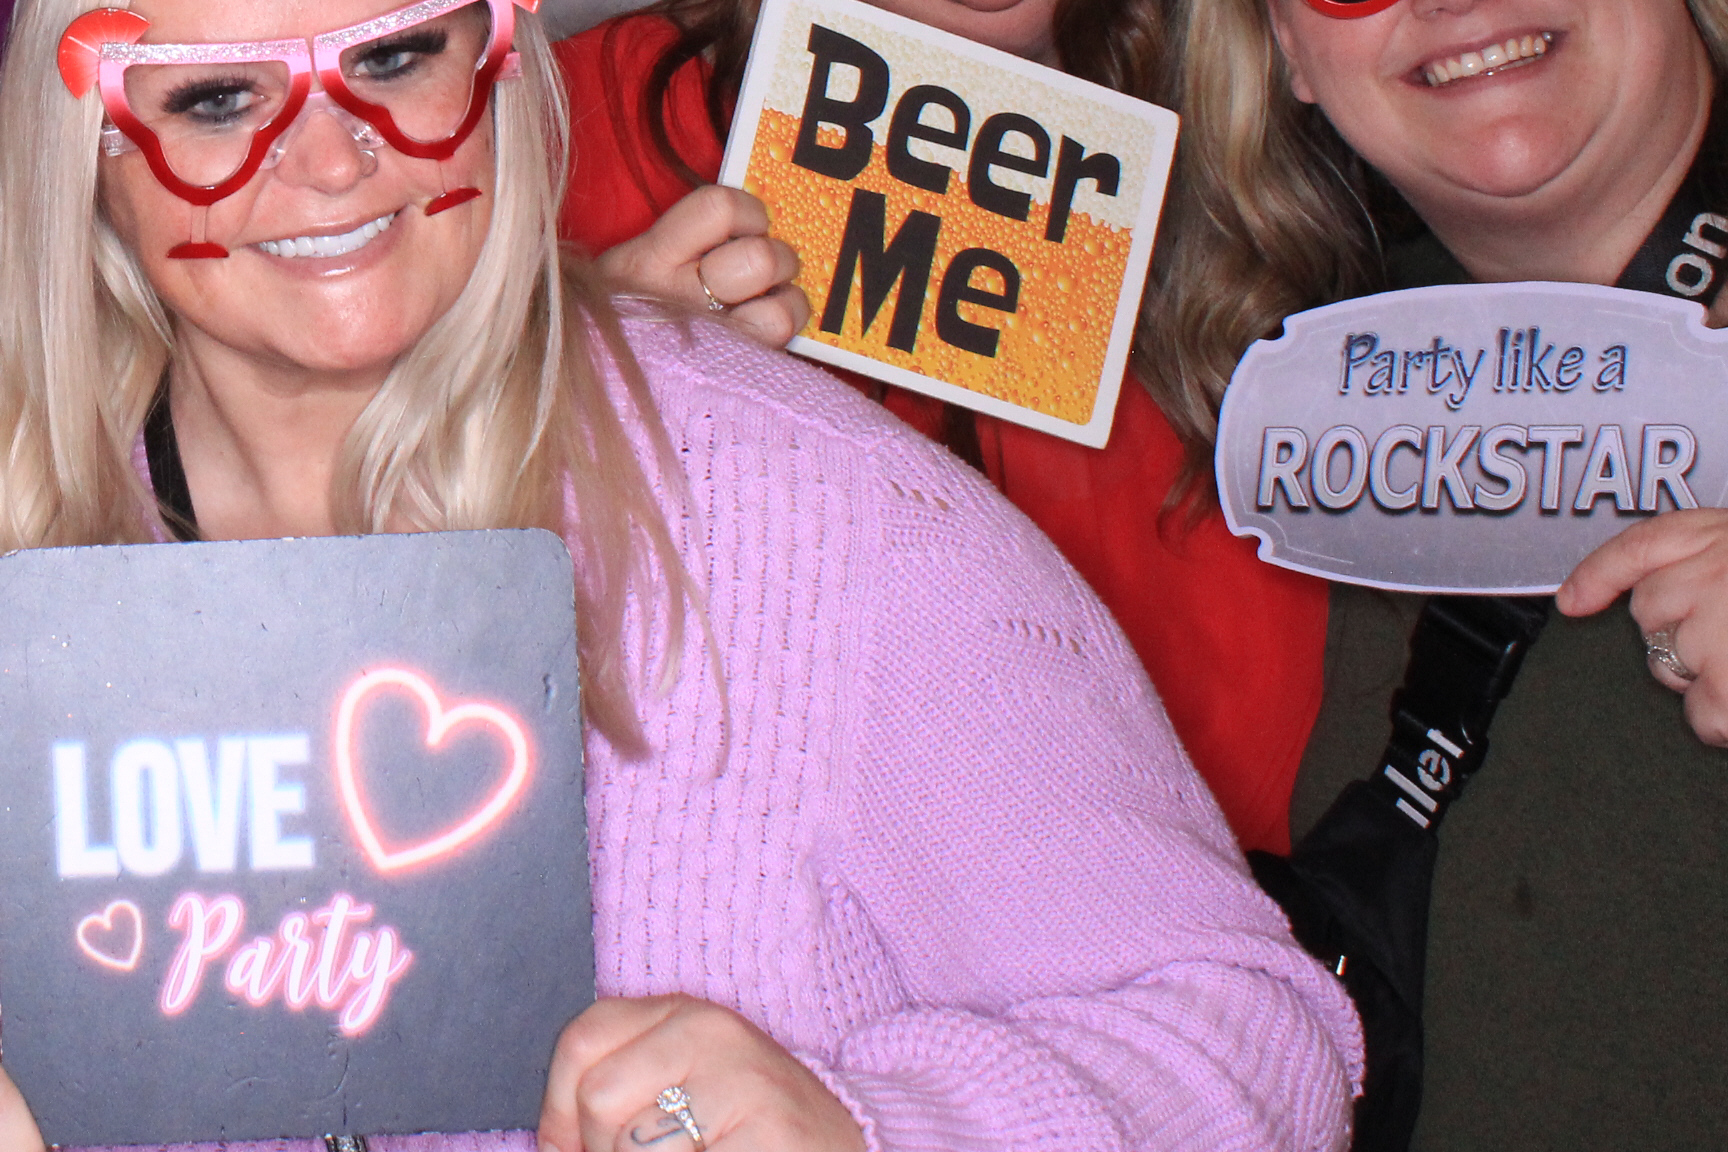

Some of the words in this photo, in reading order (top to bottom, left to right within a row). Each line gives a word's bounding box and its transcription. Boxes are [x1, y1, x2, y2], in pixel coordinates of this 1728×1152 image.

[790, 22, 1121, 244] Beer
[818, 187, 1022, 359] Me
[1338, 330, 1485, 410] Party
[1492, 325, 1586, 393] like
[1593, 342, 1629, 392] a
[1256, 423, 1700, 514] ROCKSTAR
[51, 734, 316, 879] LOVE
[160, 890, 414, 1038] Party
